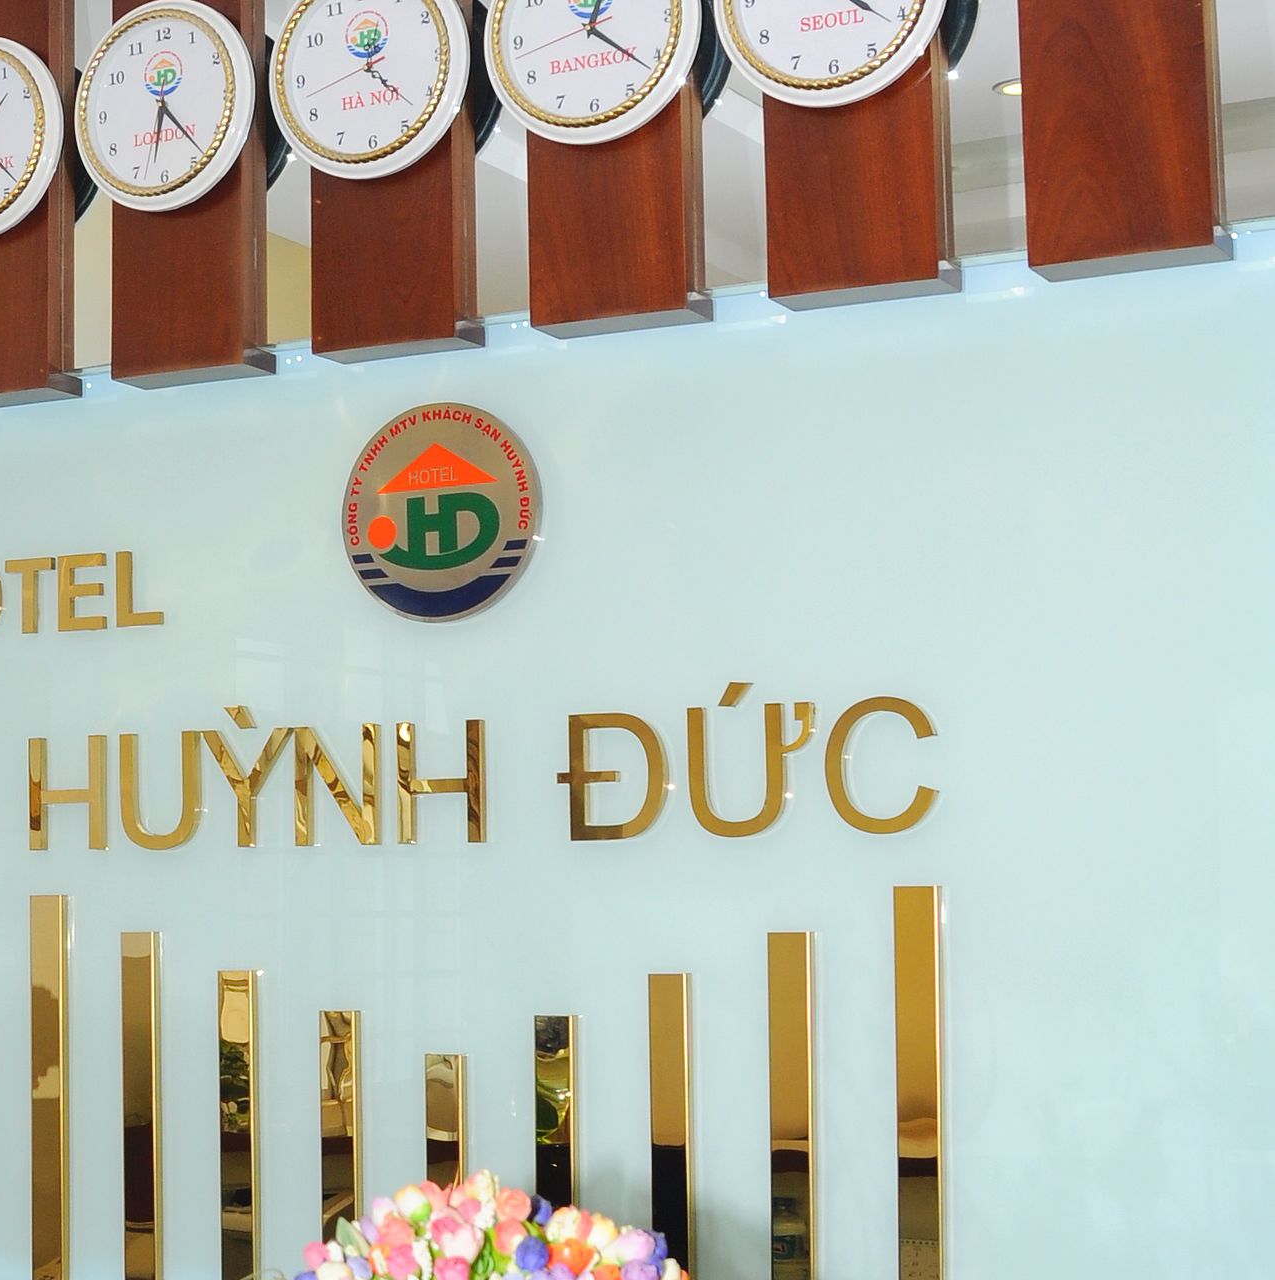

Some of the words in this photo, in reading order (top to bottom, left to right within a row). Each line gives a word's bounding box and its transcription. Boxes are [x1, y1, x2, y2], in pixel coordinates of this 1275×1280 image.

[327, 3, 343, 16] 11
[898, 6, 907, 20] 4
[421, 11, 430, 24] 2
[800, 9, 864, 32] SEOUL
[156, 27, 171, 42] 12
[189, 32, 195, 44] 1
[306, 33, 323, 48] 10
[759, 29, 769, 44] 8
[129, 42, 143, 56] 11
[514, 36, 523, 49] 9
[867, 43, 877, 58] 5
[212, 53, 220, 65] 2
[550, 47, 637, 75] BANGKOK
[791, 55, 801, 70] 7
[2, 67, 7, 79] 1
[829, 59, 839, 74] 6
[109, 71, 124, 85] 10
[297, 75, 305, 88] 9
[527, 70, 537, 84] 8
[23, 88, 30, 99] 2
[626, 83, 635, 97] 5
[342, 92, 365, 111] HÀ
[557, 95, 565, 109] 7
[590, 99, 599, 112] 6
[99, 111, 107, 124] 9
[310, 108, 318, 121] 8
[401, 121, 409, 133] 5
[134, 125, 195, 147] LONDON
[337, 132, 344, 145] 7
[369, 136, 377, 149] 6
[109, 144, 117, 156] 8
[133, 166, 140, 179] 7
[161, 171, 169, 183] 6
[422, 406, 472, 424] KHÁCH
[389, 415, 417, 438] MTV
[474, 418, 501, 442] SẠN
[359, 435, 389, 473] TNHH
[408, 466, 458, 486] HOTEL
[350, 476, 363, 496] TY
[346, 502, 360, 546] CÔNG
[28, 705, 486, 852] HUỲNH
[557, 682, 939, 842] ĐỨC
